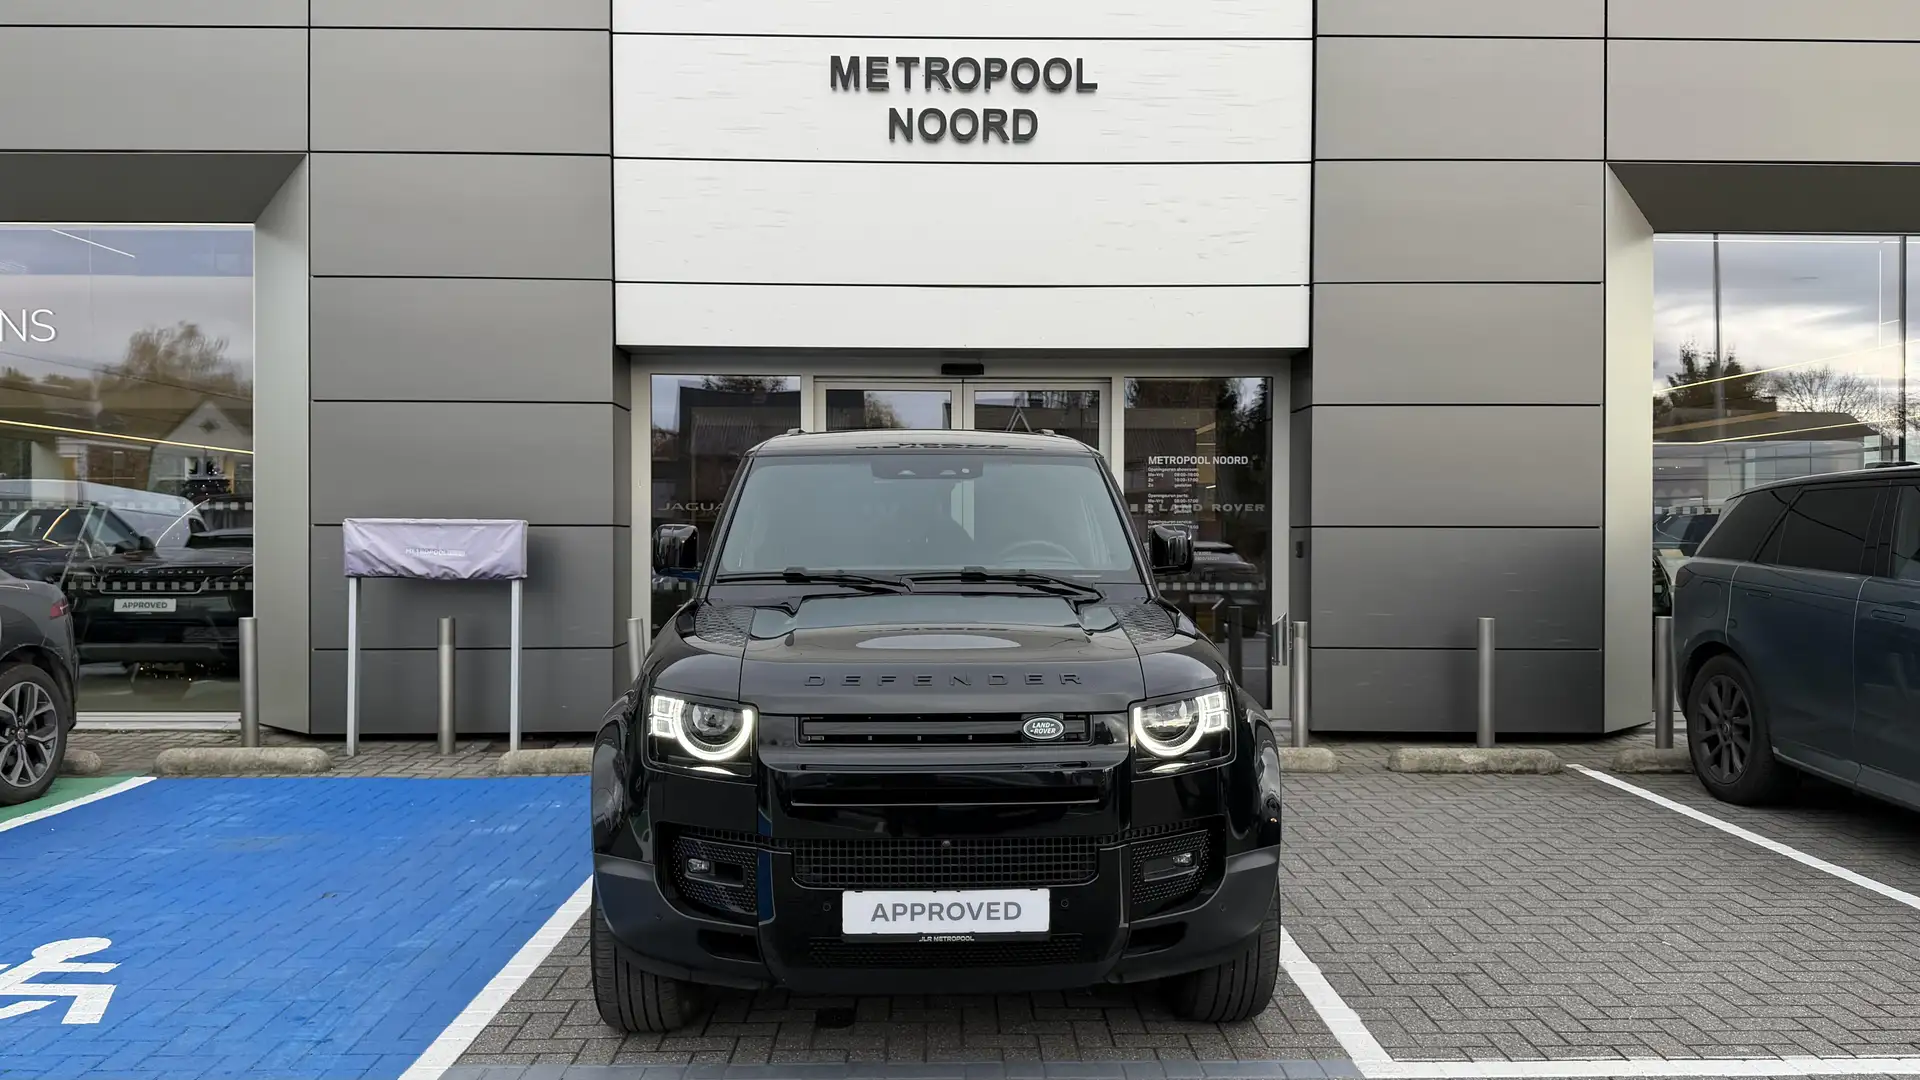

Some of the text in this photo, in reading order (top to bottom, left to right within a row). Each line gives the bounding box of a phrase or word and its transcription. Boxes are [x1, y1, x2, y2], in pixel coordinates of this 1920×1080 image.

[829, 55, 1098, 92] METROPOOL
[888, 107, 1039, 143] NOORD
[1148, 456, 1248, 465] METROPOOL NOORD
[1211, 503, 1265, 512] ROVER
[121, 601, 168, 609] APPROVED
[804, 673, 1083, 687] DEFENDER
[870, 901, 1022, 922] APPROVED
